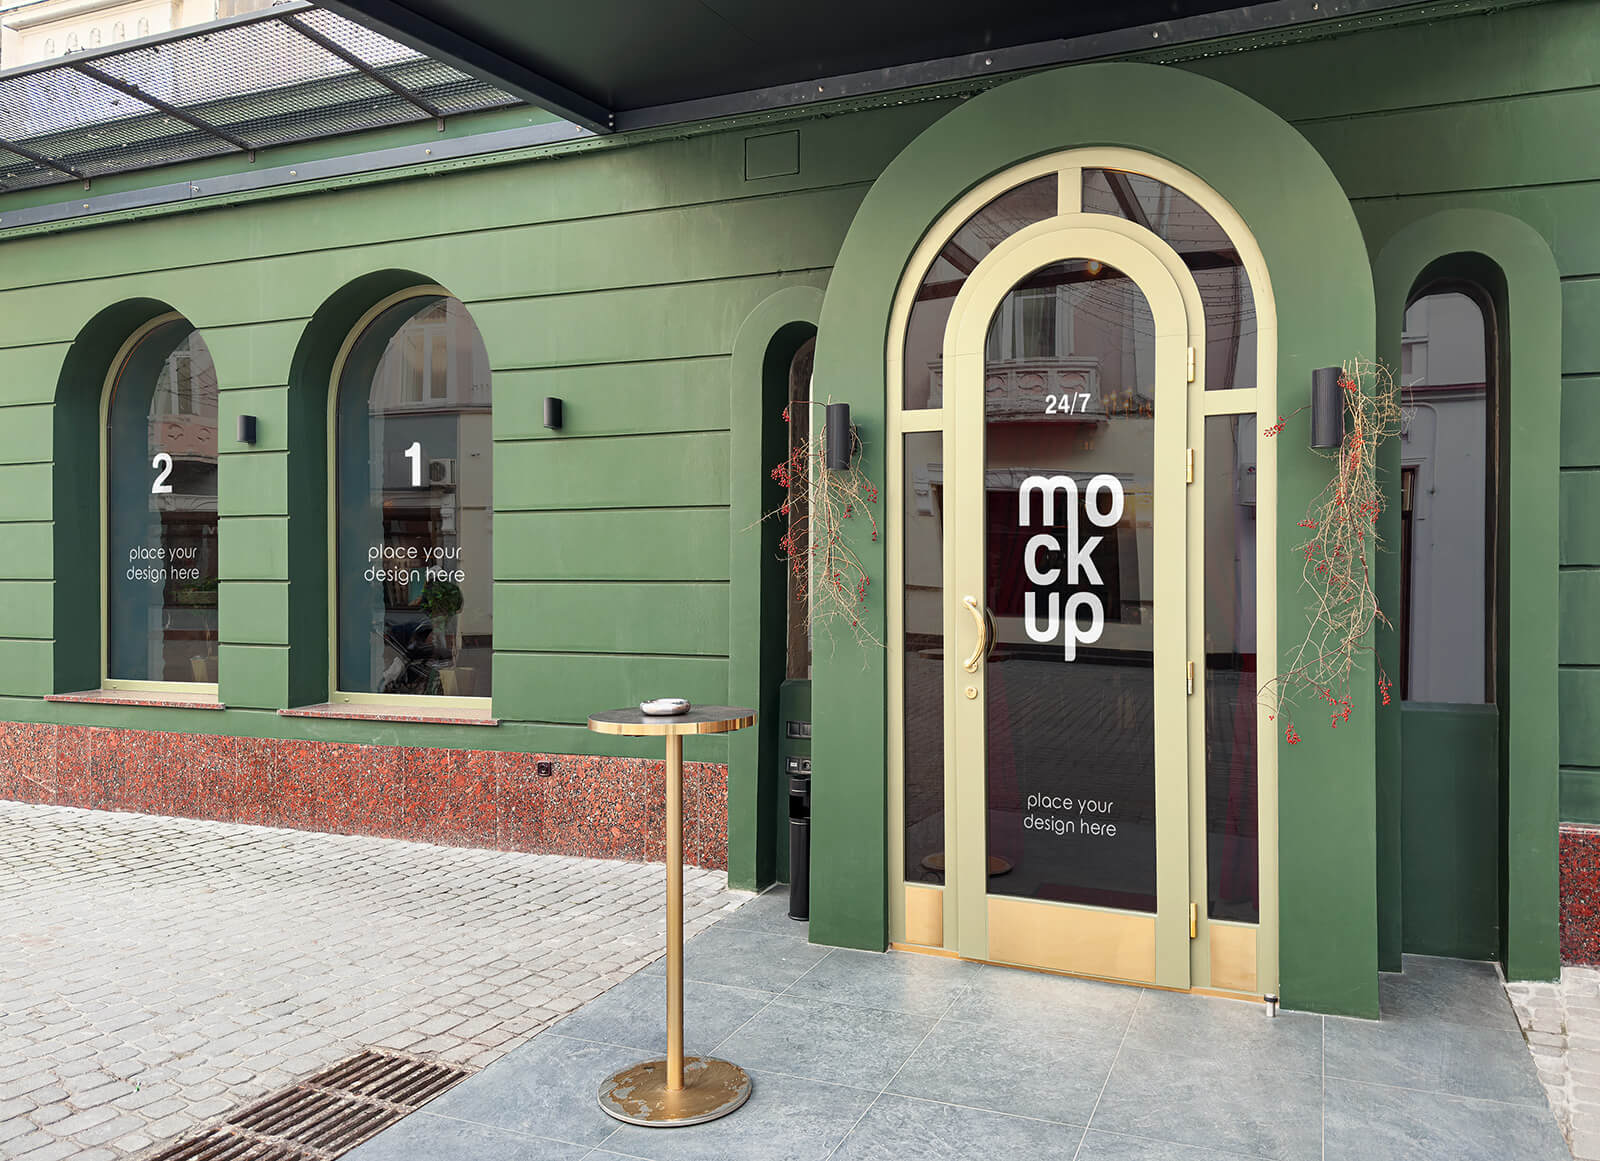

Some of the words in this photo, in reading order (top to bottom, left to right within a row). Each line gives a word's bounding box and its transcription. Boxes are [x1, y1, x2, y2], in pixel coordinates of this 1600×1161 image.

[1044, 391, 1092, 416] 24/7
[150, 452, 174, 495] 2
[403, 441, 423, 488] 1
[1018, 474, 1125, 528] mo
[128, 545, 166, 563] place
[169, 547, 197, 563] your
[367, 543, 418, 563] place
[423, 546, 463, 563] your
[1024, 533, 1105, 586] ck
[125, 566, 167, 584] design
[170, 566, 200, 581] here
[363, 565, 420, 586] design
[426, 566, 466, 584] here
[1024, 591, 1105, 663] up
[1027, 792, 1073, 811] place
[1077, 799, 1113, 815] your
[1023, 814, 1075, 836] design
[1080, 818, 1117, 838] here
